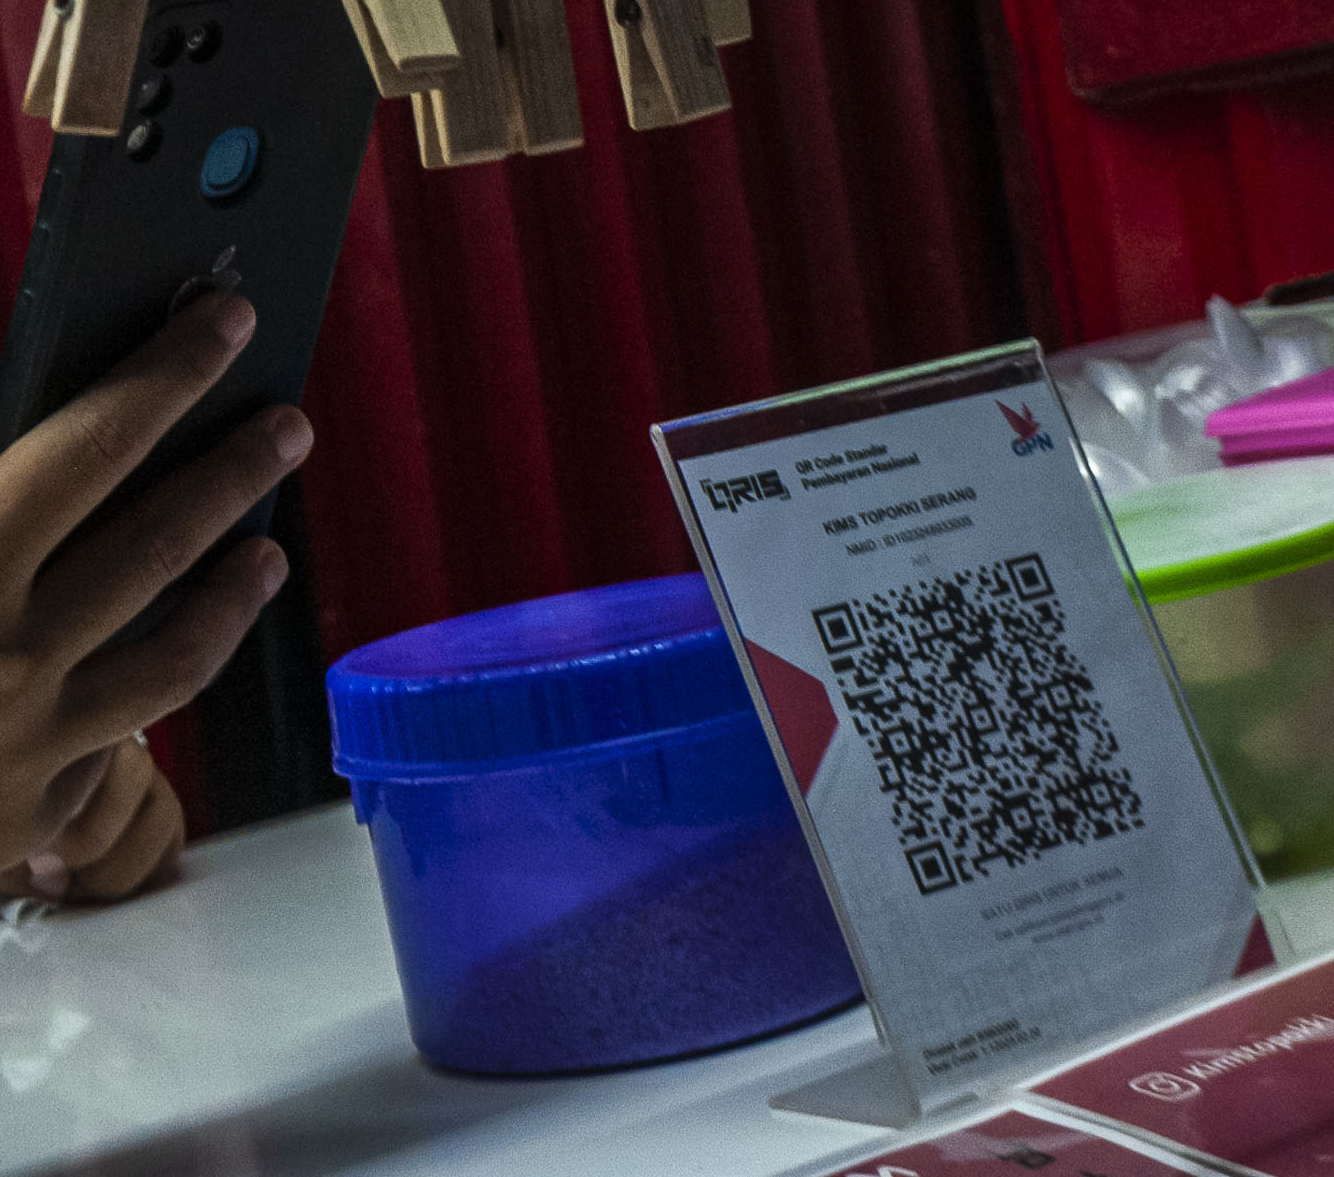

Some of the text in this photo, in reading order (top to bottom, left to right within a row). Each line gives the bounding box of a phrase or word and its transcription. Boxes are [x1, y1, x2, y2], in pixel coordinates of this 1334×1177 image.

[795, 443, 888, 476] QR Code Standar
[1010, 433, 1055, 458] GPN
[800, 452, 921, 491] Pembayaran Nasional
[699, 469, 792, 514] QRIS
[822, 486, 977, 538] KIMS TOPOKKI SERANG
